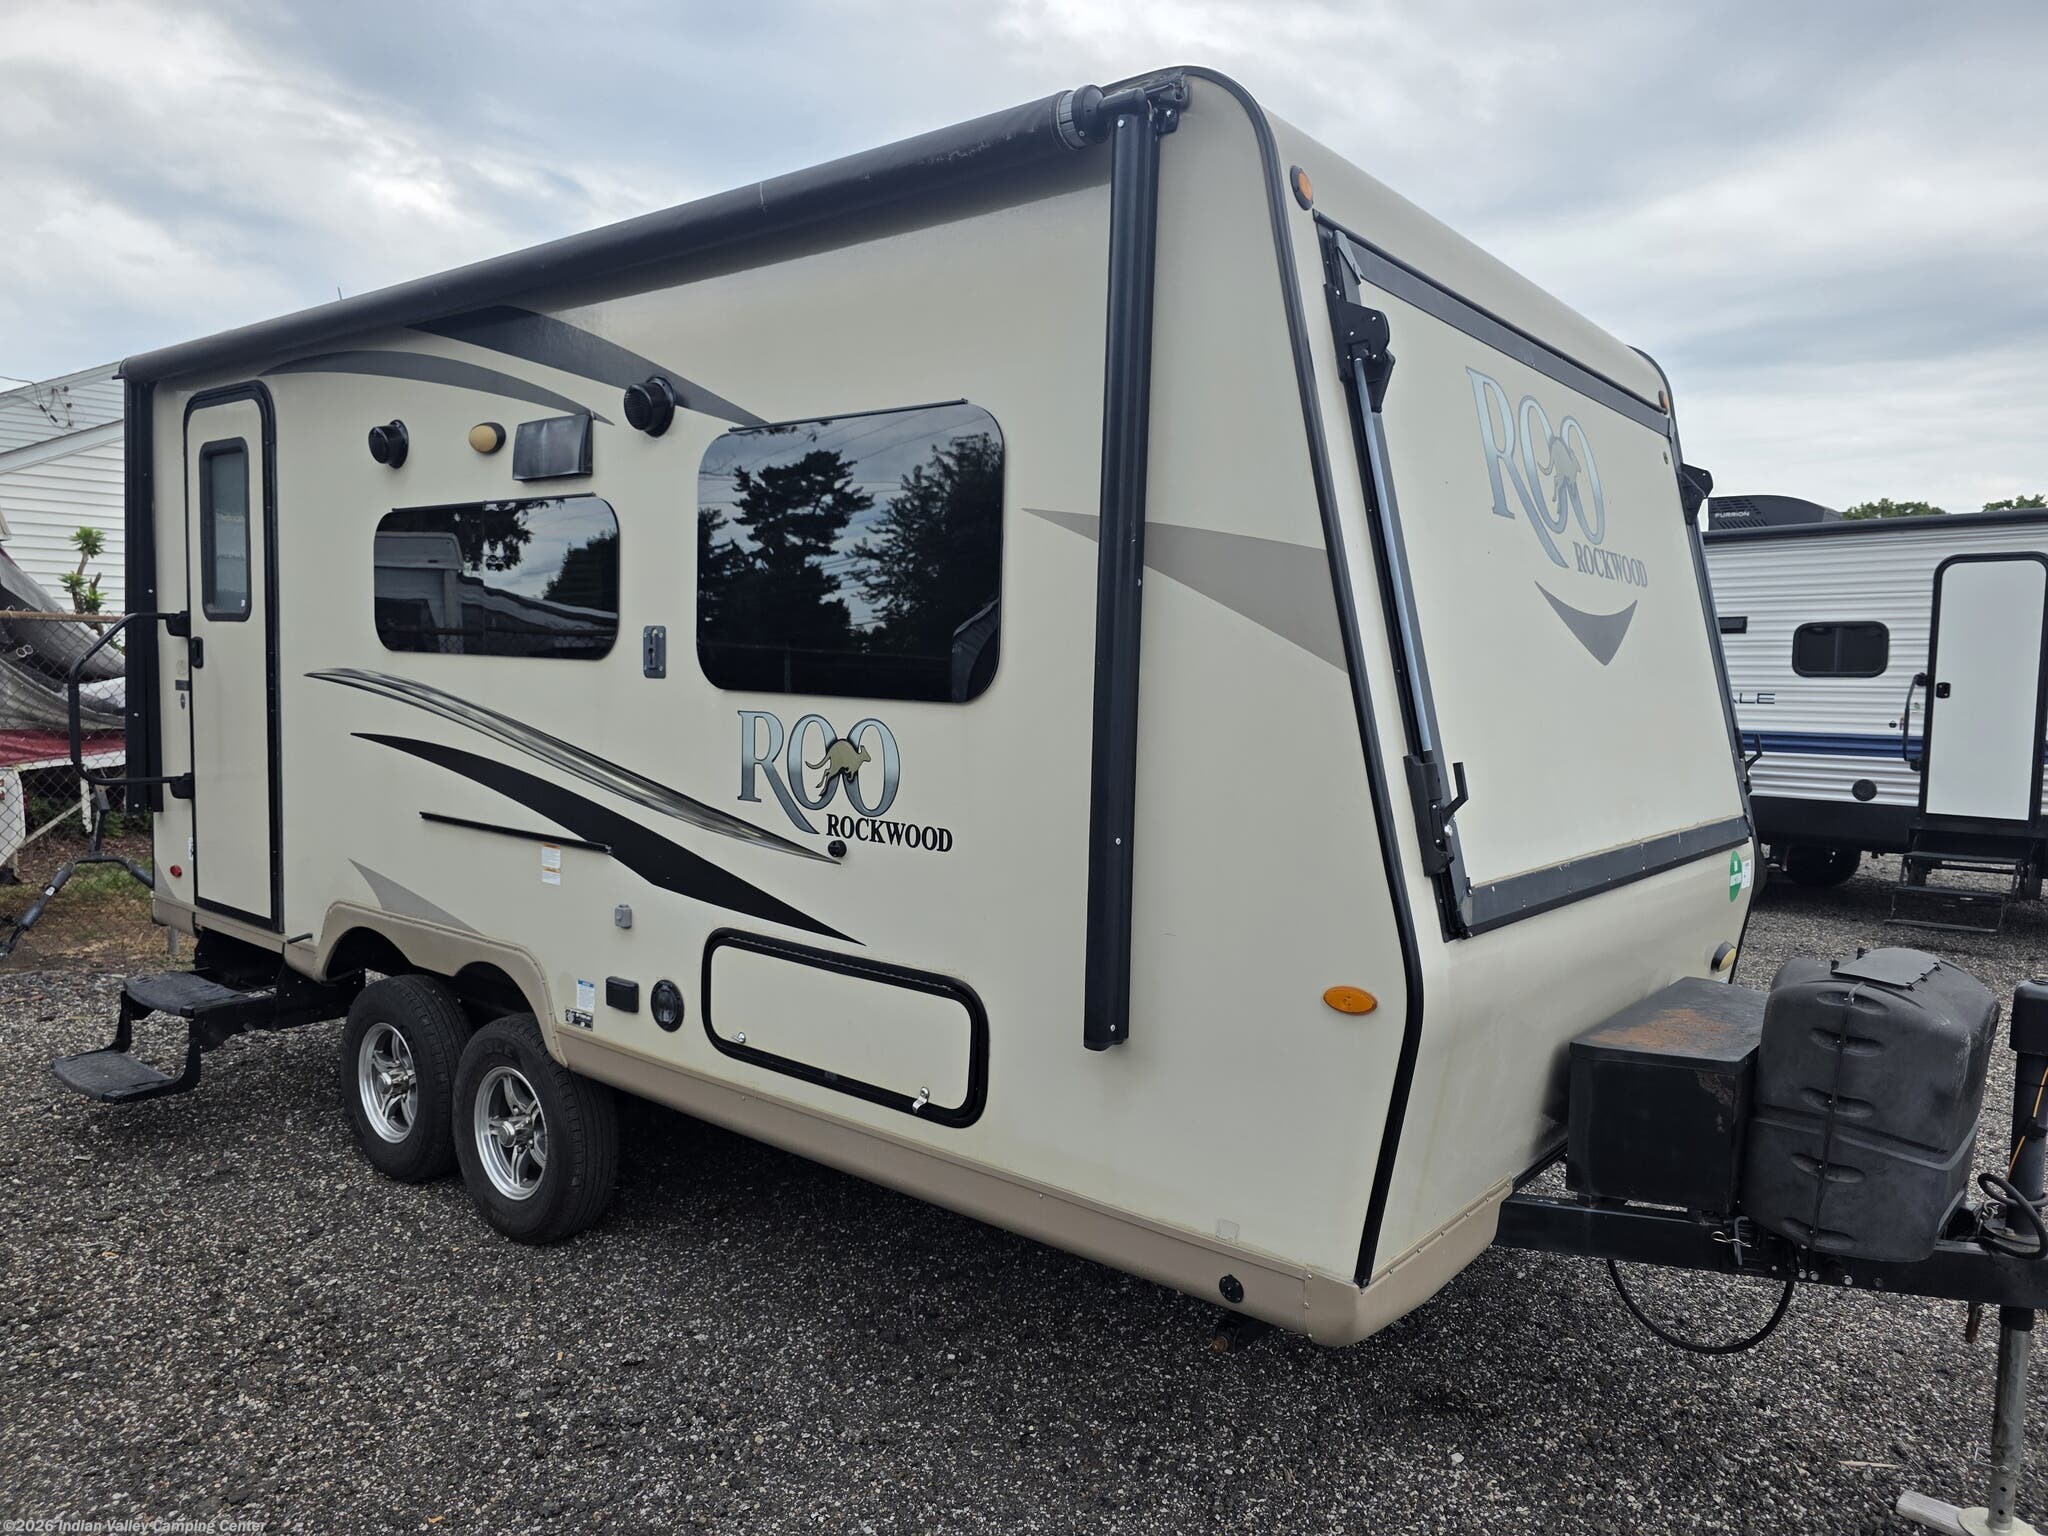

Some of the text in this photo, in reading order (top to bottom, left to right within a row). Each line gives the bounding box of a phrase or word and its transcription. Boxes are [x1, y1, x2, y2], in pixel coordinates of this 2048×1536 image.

[1465, 365, 1605, 568] ROO
[1573, 541, 1648, 588] ROCKWOOD
[737, 710, 901, 835] ROO
[826, 813, 953, 852] ROCKWOOD
